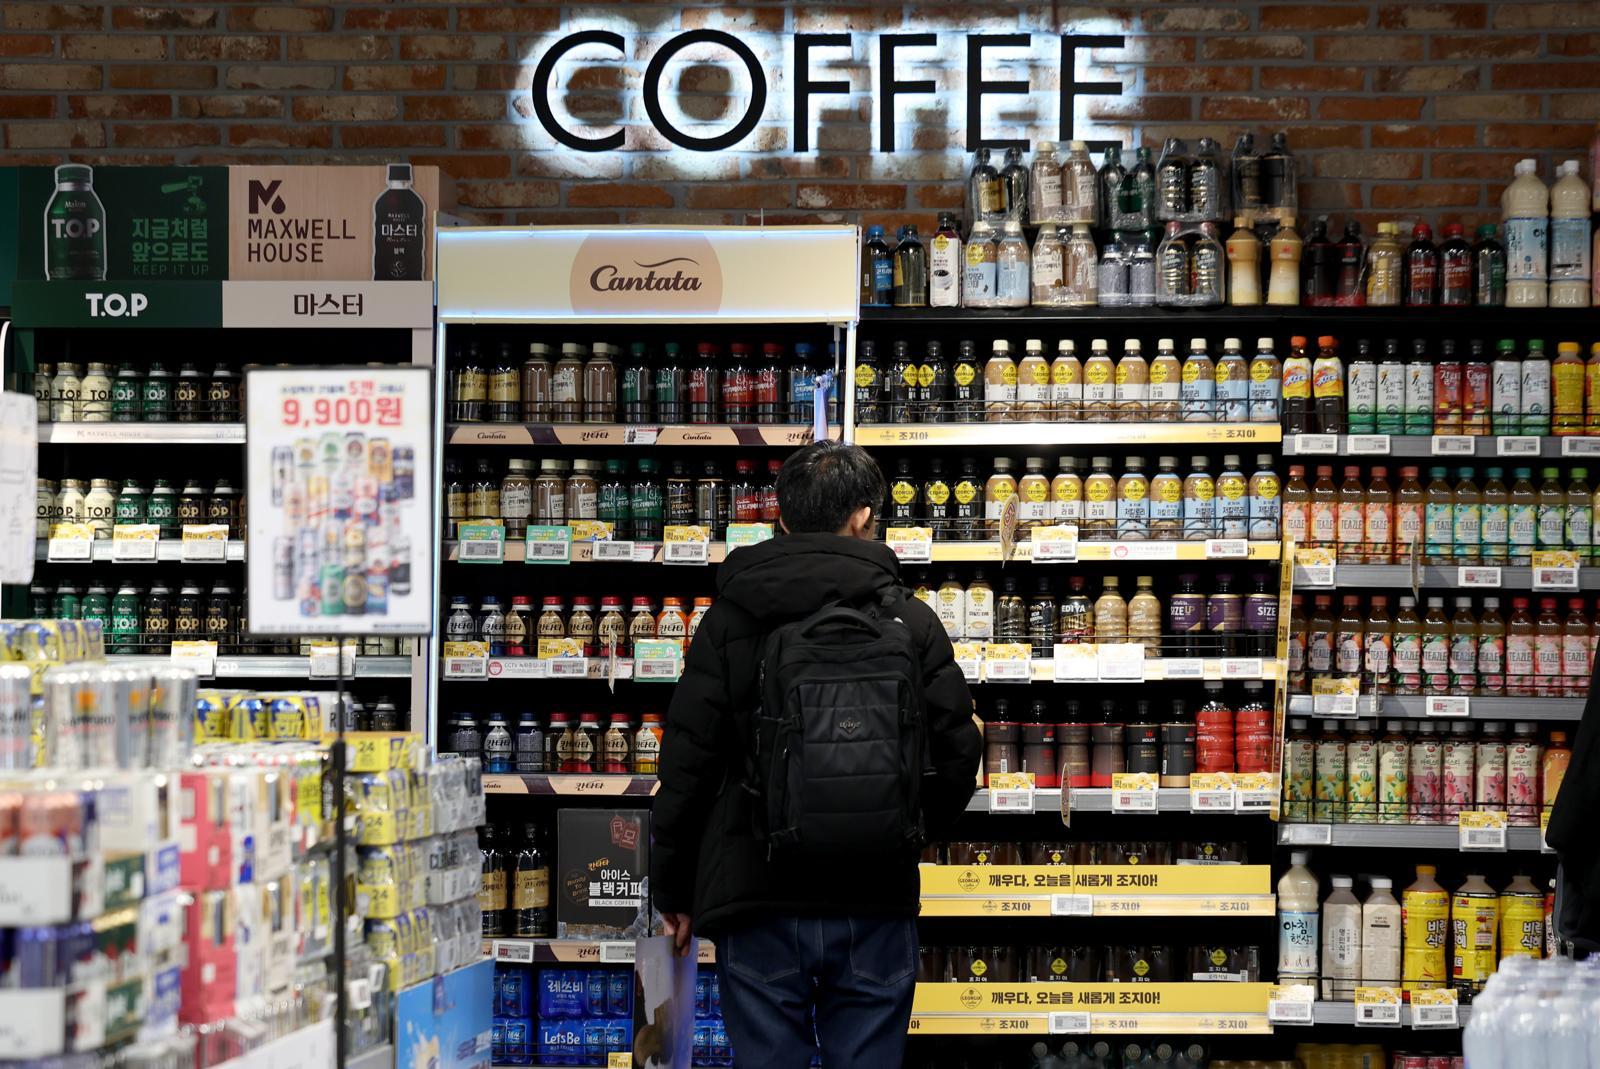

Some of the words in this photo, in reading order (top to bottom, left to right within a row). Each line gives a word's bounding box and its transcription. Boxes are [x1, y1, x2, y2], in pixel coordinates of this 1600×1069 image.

[532, 28, 1126, 153] COFFEE
[51, 218, 100, 239] T.O.P
[132, 218, 208, 240] 지금처럼
[248, 218, 356, 240] MAXWELL
[381, 223, 417, 236] 마스터
[132, 242, 208, 263] 앞으로도
[248, 242, 324, 263] HOUSE
[134, 264, 167, 276] KEEP
[173, 264, 184, 276] IT
[192, 264, 209, 276] UP
[590, 257, 702, 292] Cantata
[85, 293, 148, 317] T.O.P
[294, 292, 364, 317] 마스터
[282, 397, 403, 427] 9,900원
[899, 431, 929, 441] 조지아
[1226, 429, 1256, 439] 조지아
[1061, 604, 1086, 613] EDIYA
[1257, 606, 1277, 617] SIZE
[575, 782, 605, 792] 칸타타
[600, 869, 631, 881] 아이스
[988, 873, 1030, 888] 깨우다,
[1034, 873, 1071, 887] 오늘을
[1075, 873, 1113, 887] 새롭게
[1116, 873, 1158, 887] 조지아!
[588, 881, 642, 897] 블랙커피
[1001, 902, 1031, 912] 조지아
[1110, 902, 1140, 912] 조지아
[1219, 902, 1250, 912] 조지아
[1283, 918, 1308, 932] 아침
[1426, 918, 1447, 933] 비락
[547, 979, 584, 993] 레쓰비
[991, 990, 1032, 1005] 깨우다,
[1036, 990, 1074, 1004] 오늘을
[1078, 990, 1115, 1004] 새롭게
[1119, 990, 1160, 1004] 조지아!
[999, 1019, 1030, 1029] 조지아
[1108, 1019, 1138, 1029] 조지아
[1217, 1019, 1248, 1029] 조지아
